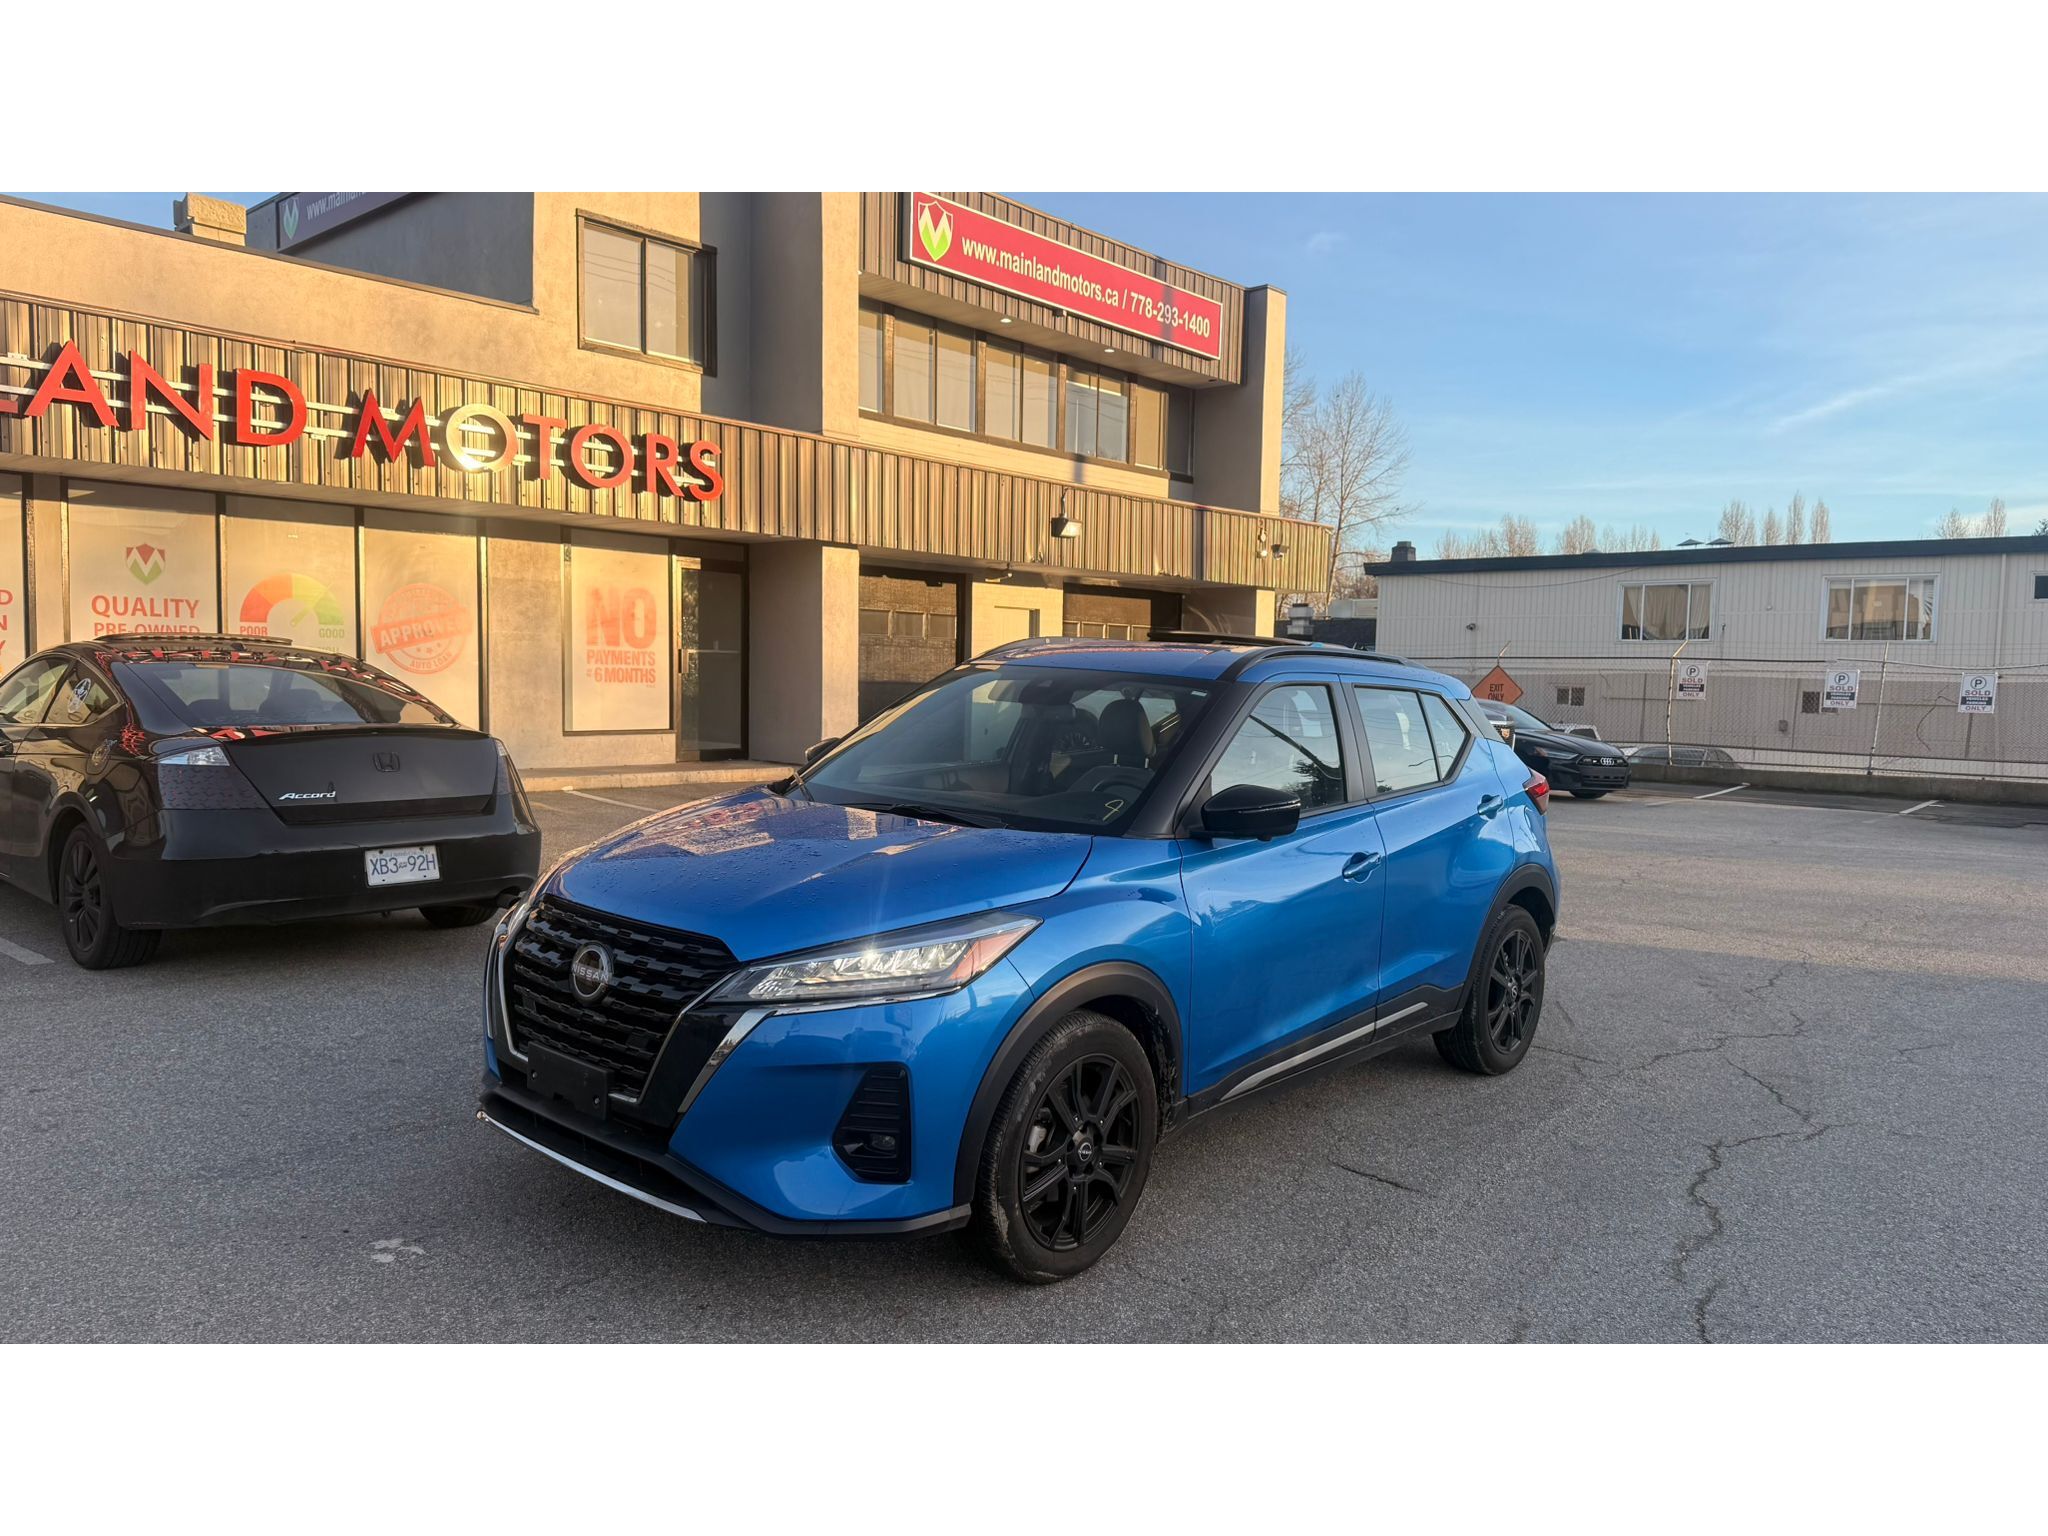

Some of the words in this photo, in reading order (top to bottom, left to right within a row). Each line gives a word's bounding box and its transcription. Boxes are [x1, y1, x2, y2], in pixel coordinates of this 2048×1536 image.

[962, 236, 1119, 307] www.mainlandmotors.ca
[1130, 291, 1211, 338] 778-293-1400
[0, 338, 307, 446] AND
[351, 388, 724, 501] MOTORS
[91, 595, 200, 618] QUALITY
[586, 586, 657, 649] NO
[240, 625, 268, 636] POOR
[319, 628, 345, 638] GOOD
[586, 649, 656, 666] PAYMENTS
[604, 667, 656, 683] MONTHS
[1489, 683, 1505, 692] EXIT
[278, 790, 336, 800] Accord
[572, 962, 609, 983] NISSAN
